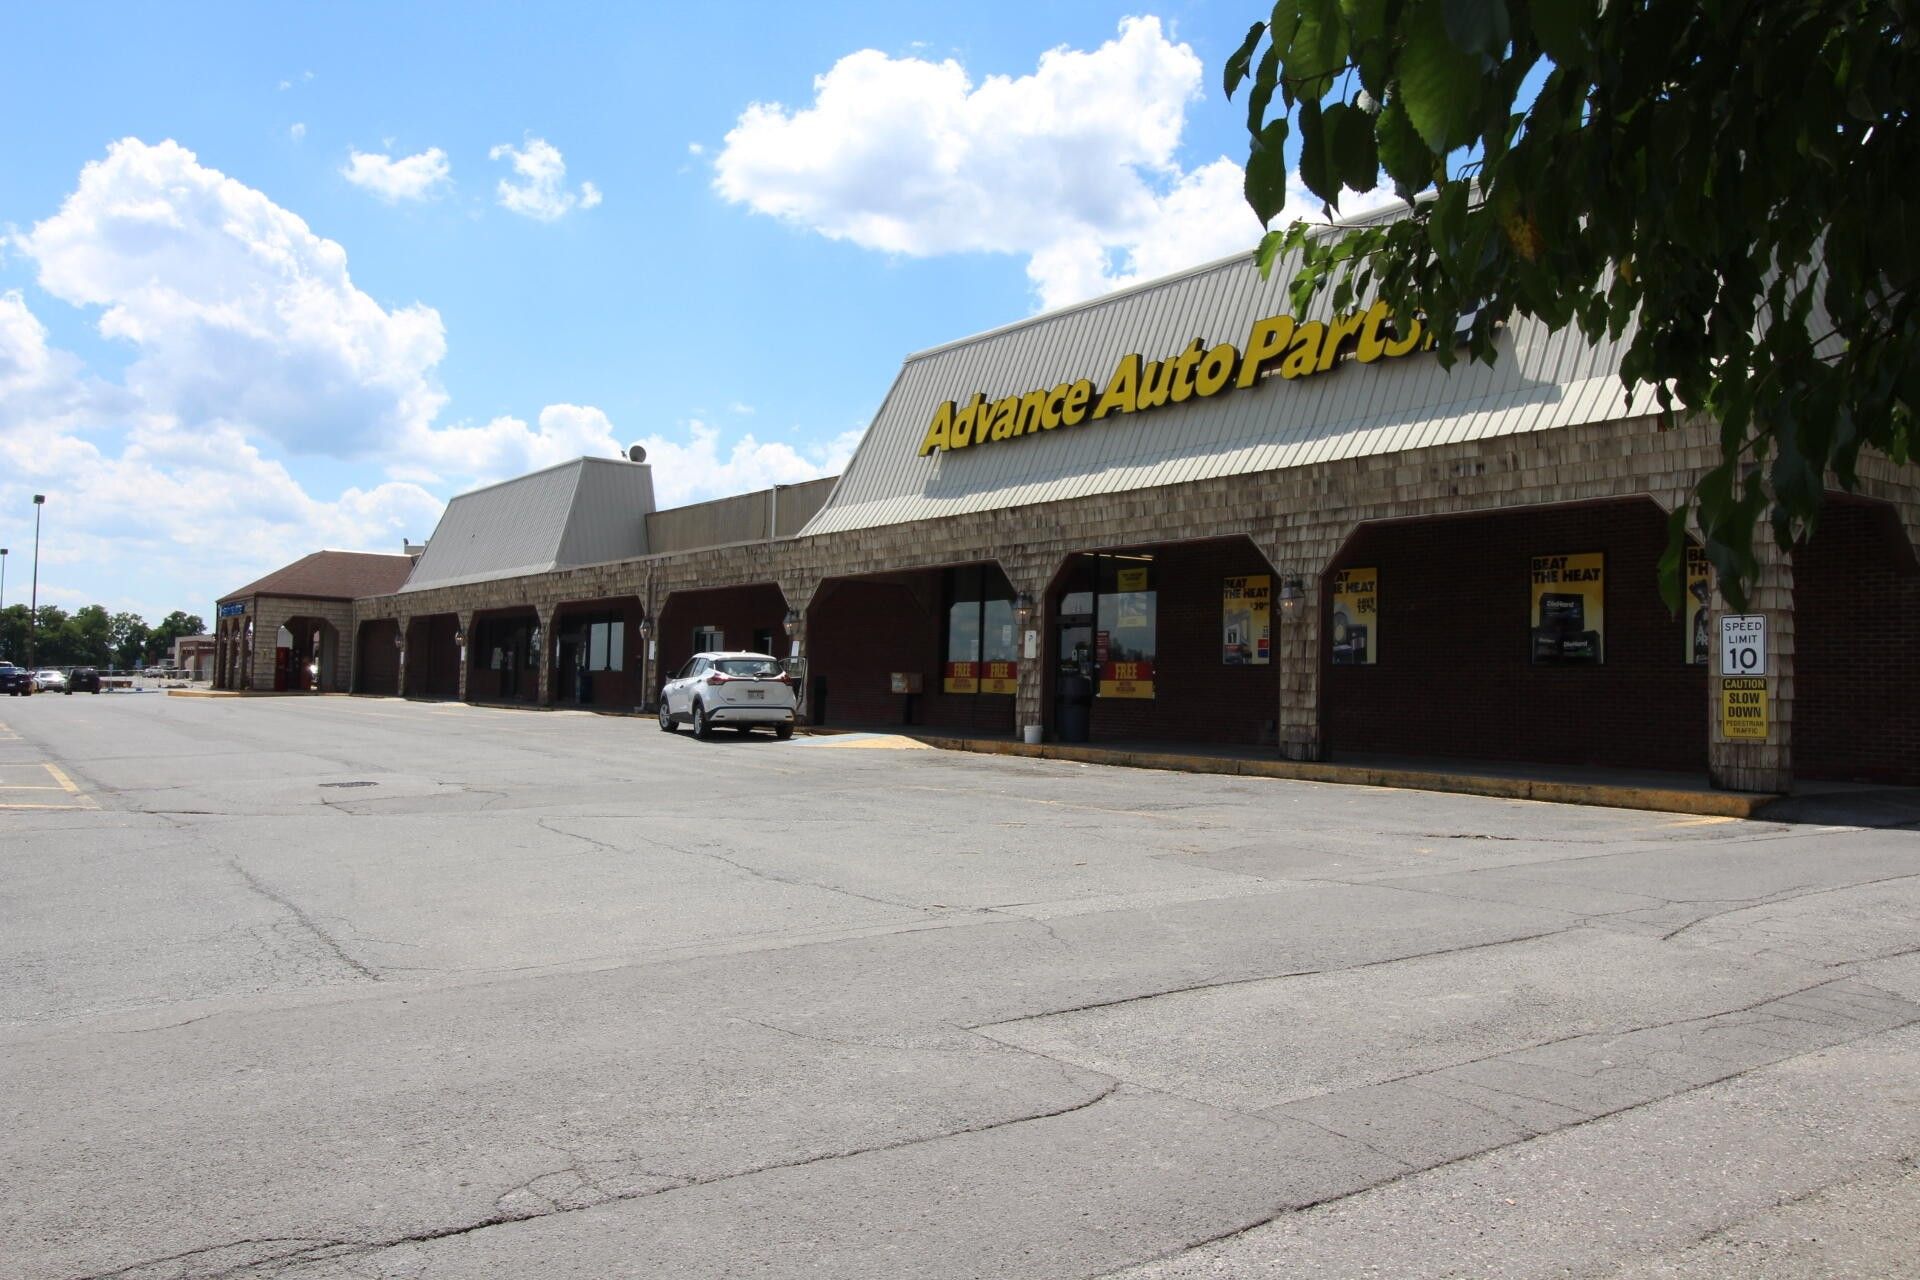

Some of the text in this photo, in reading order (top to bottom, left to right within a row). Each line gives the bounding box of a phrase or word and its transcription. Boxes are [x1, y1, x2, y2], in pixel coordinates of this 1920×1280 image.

[918, 298, 1423, 457] Advance Auto Parts
[1533, 557, 1568, 570] BEAT
[1533, 568, 1601, 584] THE HEAT
[1223, 587, 1268, 599] THE HEAT
[1346, 581, 1375, 593] HEAT
[1725, 622, 1762, 632] SPEED
[1728, 635, 1758, 644] LIMIT
[1729, 647, 1758, 669] 10
[954, 663, 972, 678] FREE
[990, 663, 1009, 678] FREE
[1114, 663, 1138, 680] FREE
[1724, 679, 1765, 689] CAUTION
[1728, 692, 1760, 704] SLOW
[1728, 706, 1761, 718] DOWN
[1725, 719, 1764, 727] PEDESTRIAN
[1732, 727, 1759, 735] TRAFFIC
